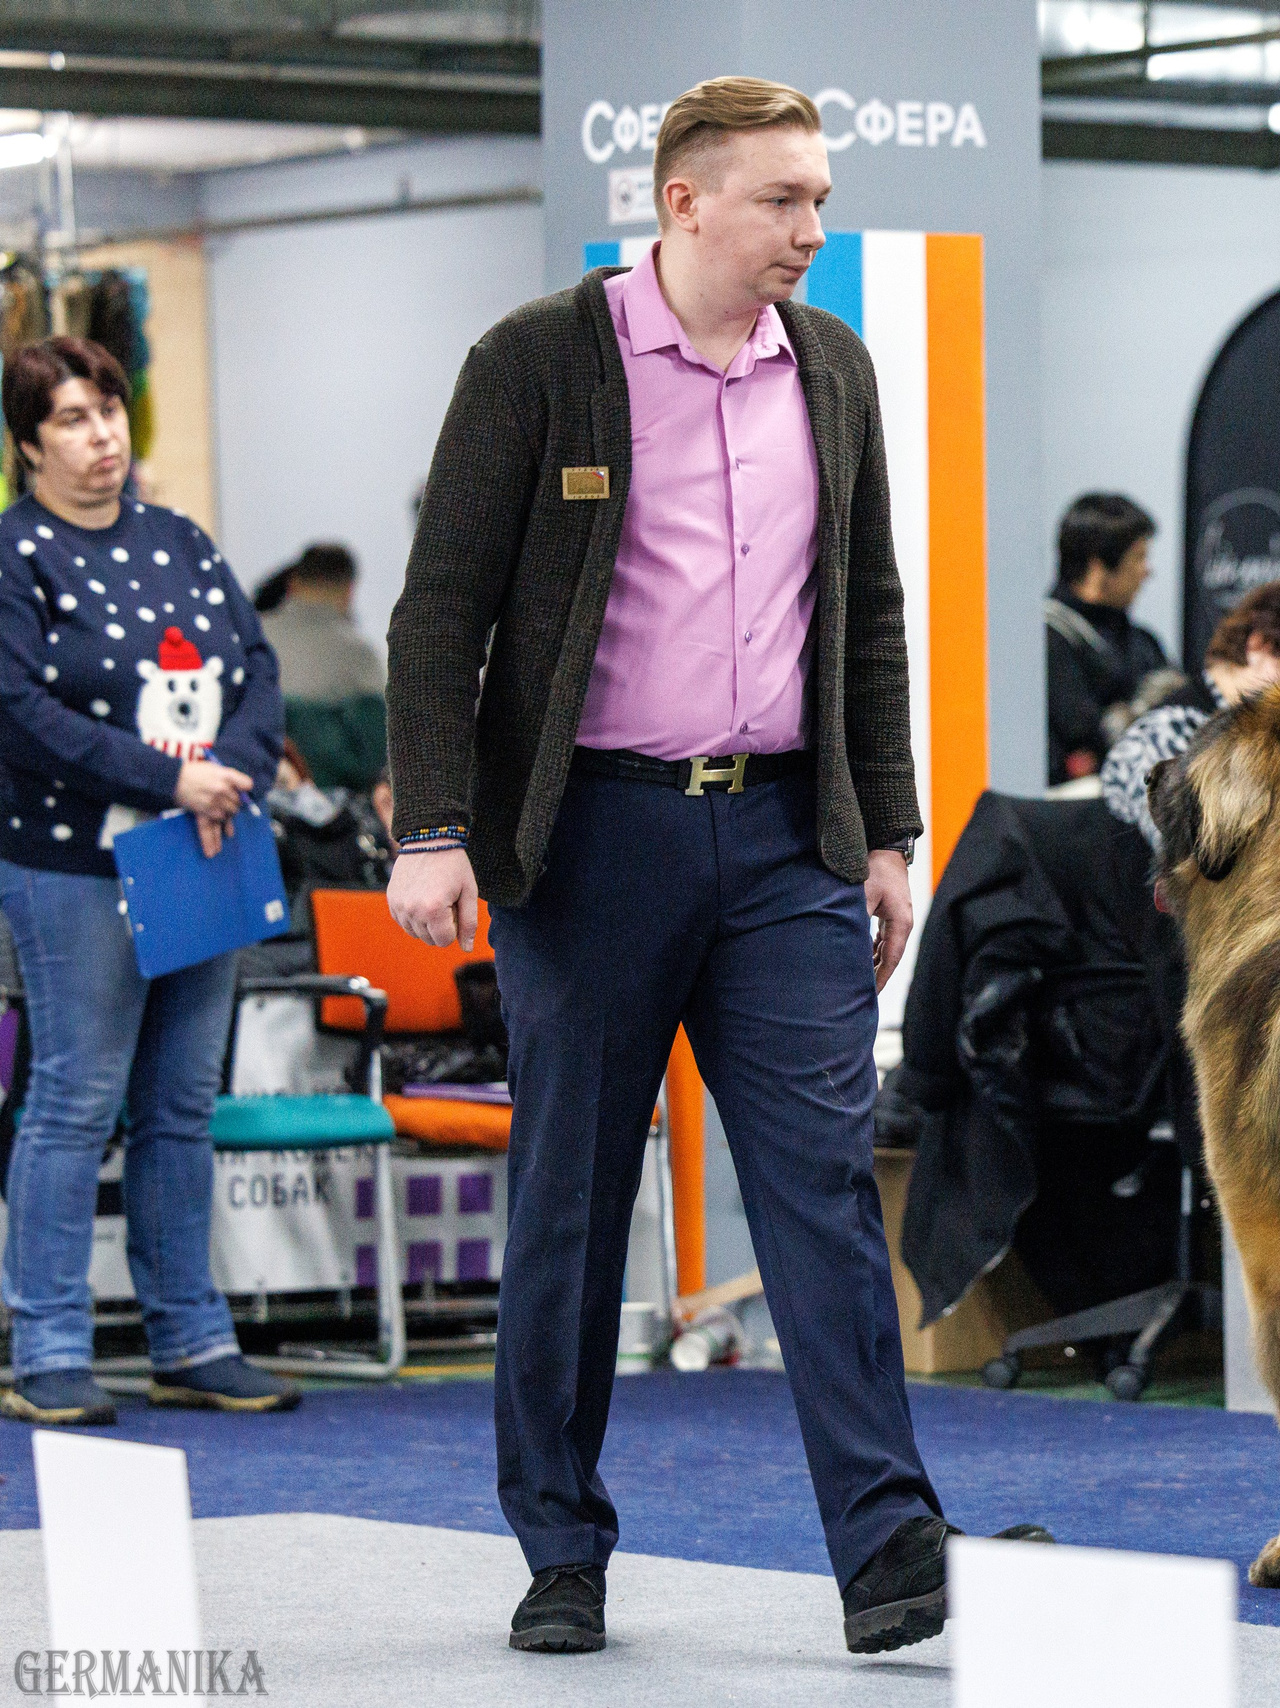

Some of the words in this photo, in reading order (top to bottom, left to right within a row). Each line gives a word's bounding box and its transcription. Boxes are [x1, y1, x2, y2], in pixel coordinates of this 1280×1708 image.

[581, 100, 672, 164] СФЕ
[813, 88, 988, 152] СФЕРА
[228, 1172, 332, 1209] СОБАК
